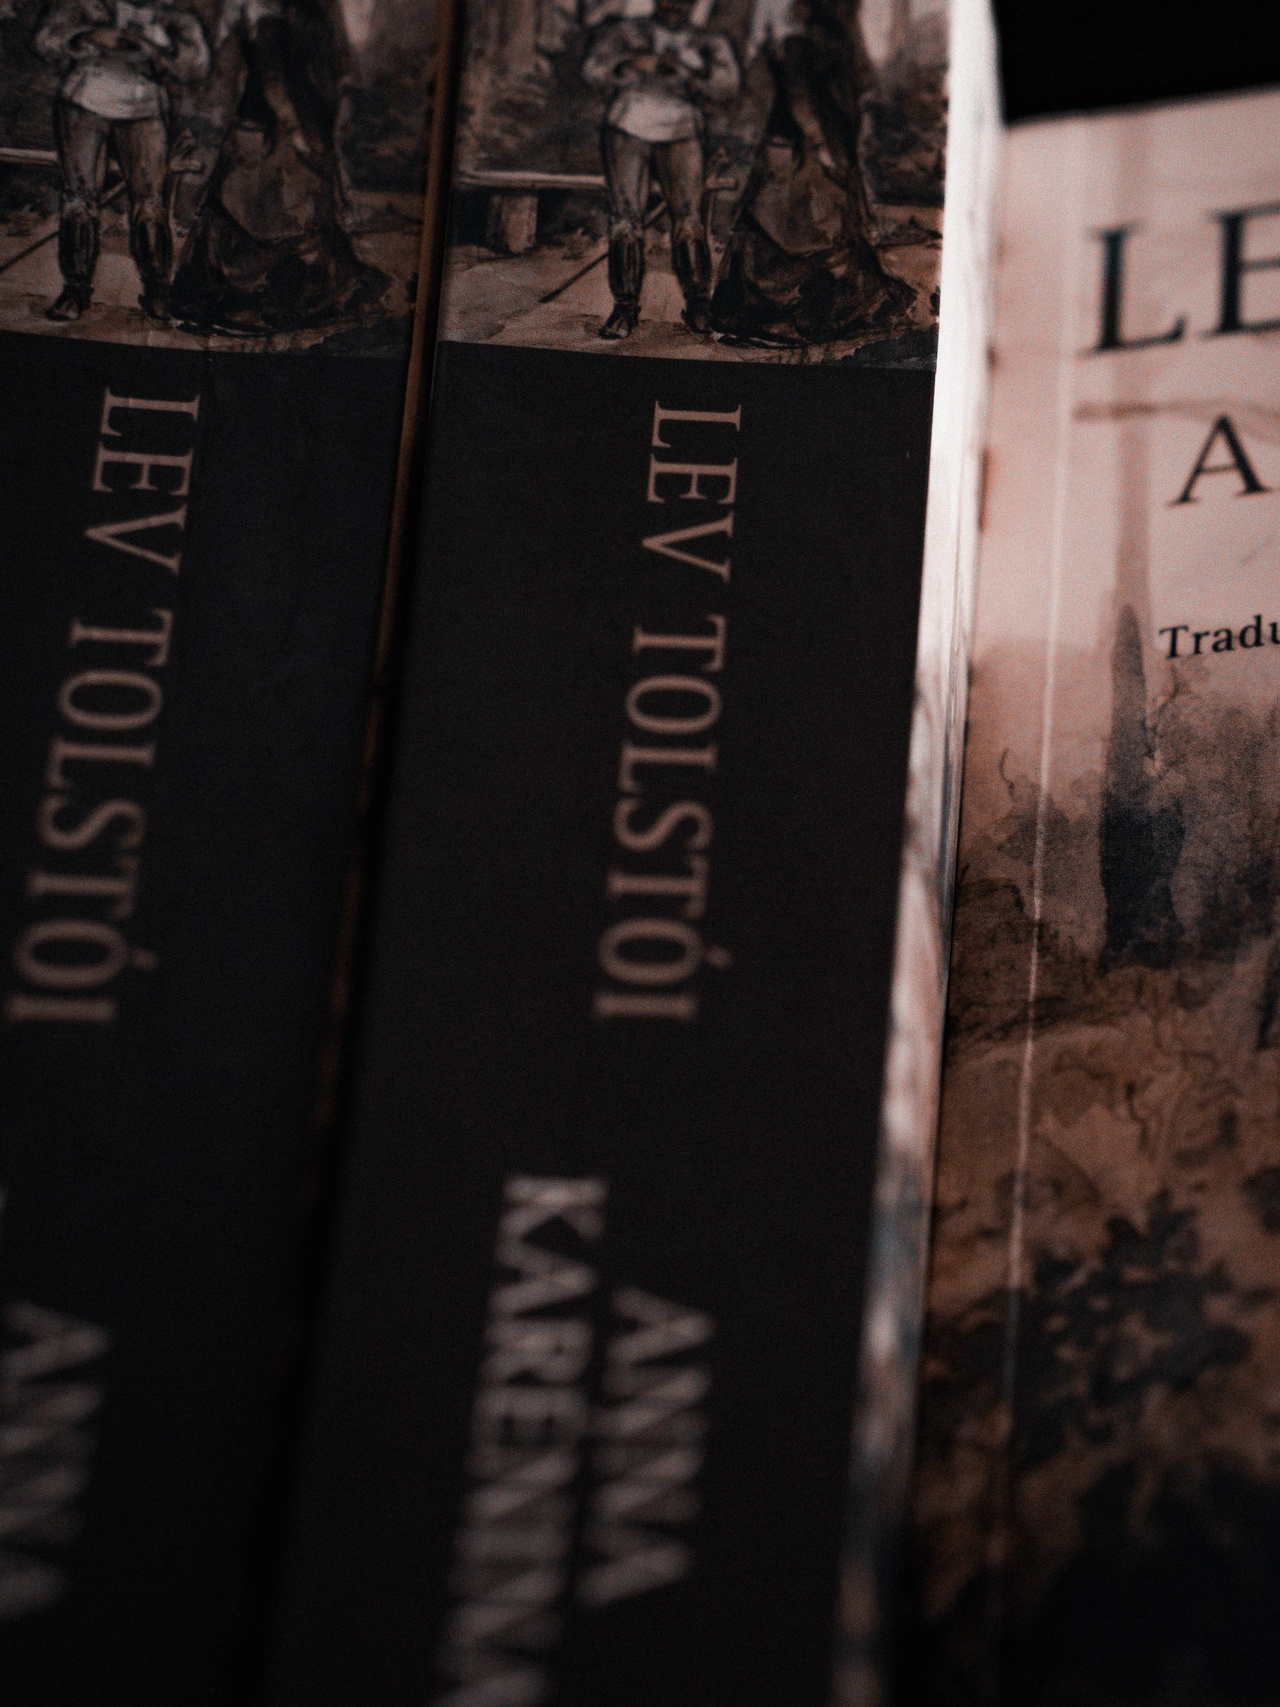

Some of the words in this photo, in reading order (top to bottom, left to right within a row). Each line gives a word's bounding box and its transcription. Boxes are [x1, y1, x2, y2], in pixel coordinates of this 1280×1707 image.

[82, 386, 201, 577] LEV
[640, 400, 743, 583] LEV
[4, 606, 174, 1025] TOLSTÓI
[590, 613, 735, 1024] TOLSTÓI
[572, 1286, 716, 1608] ANNA
